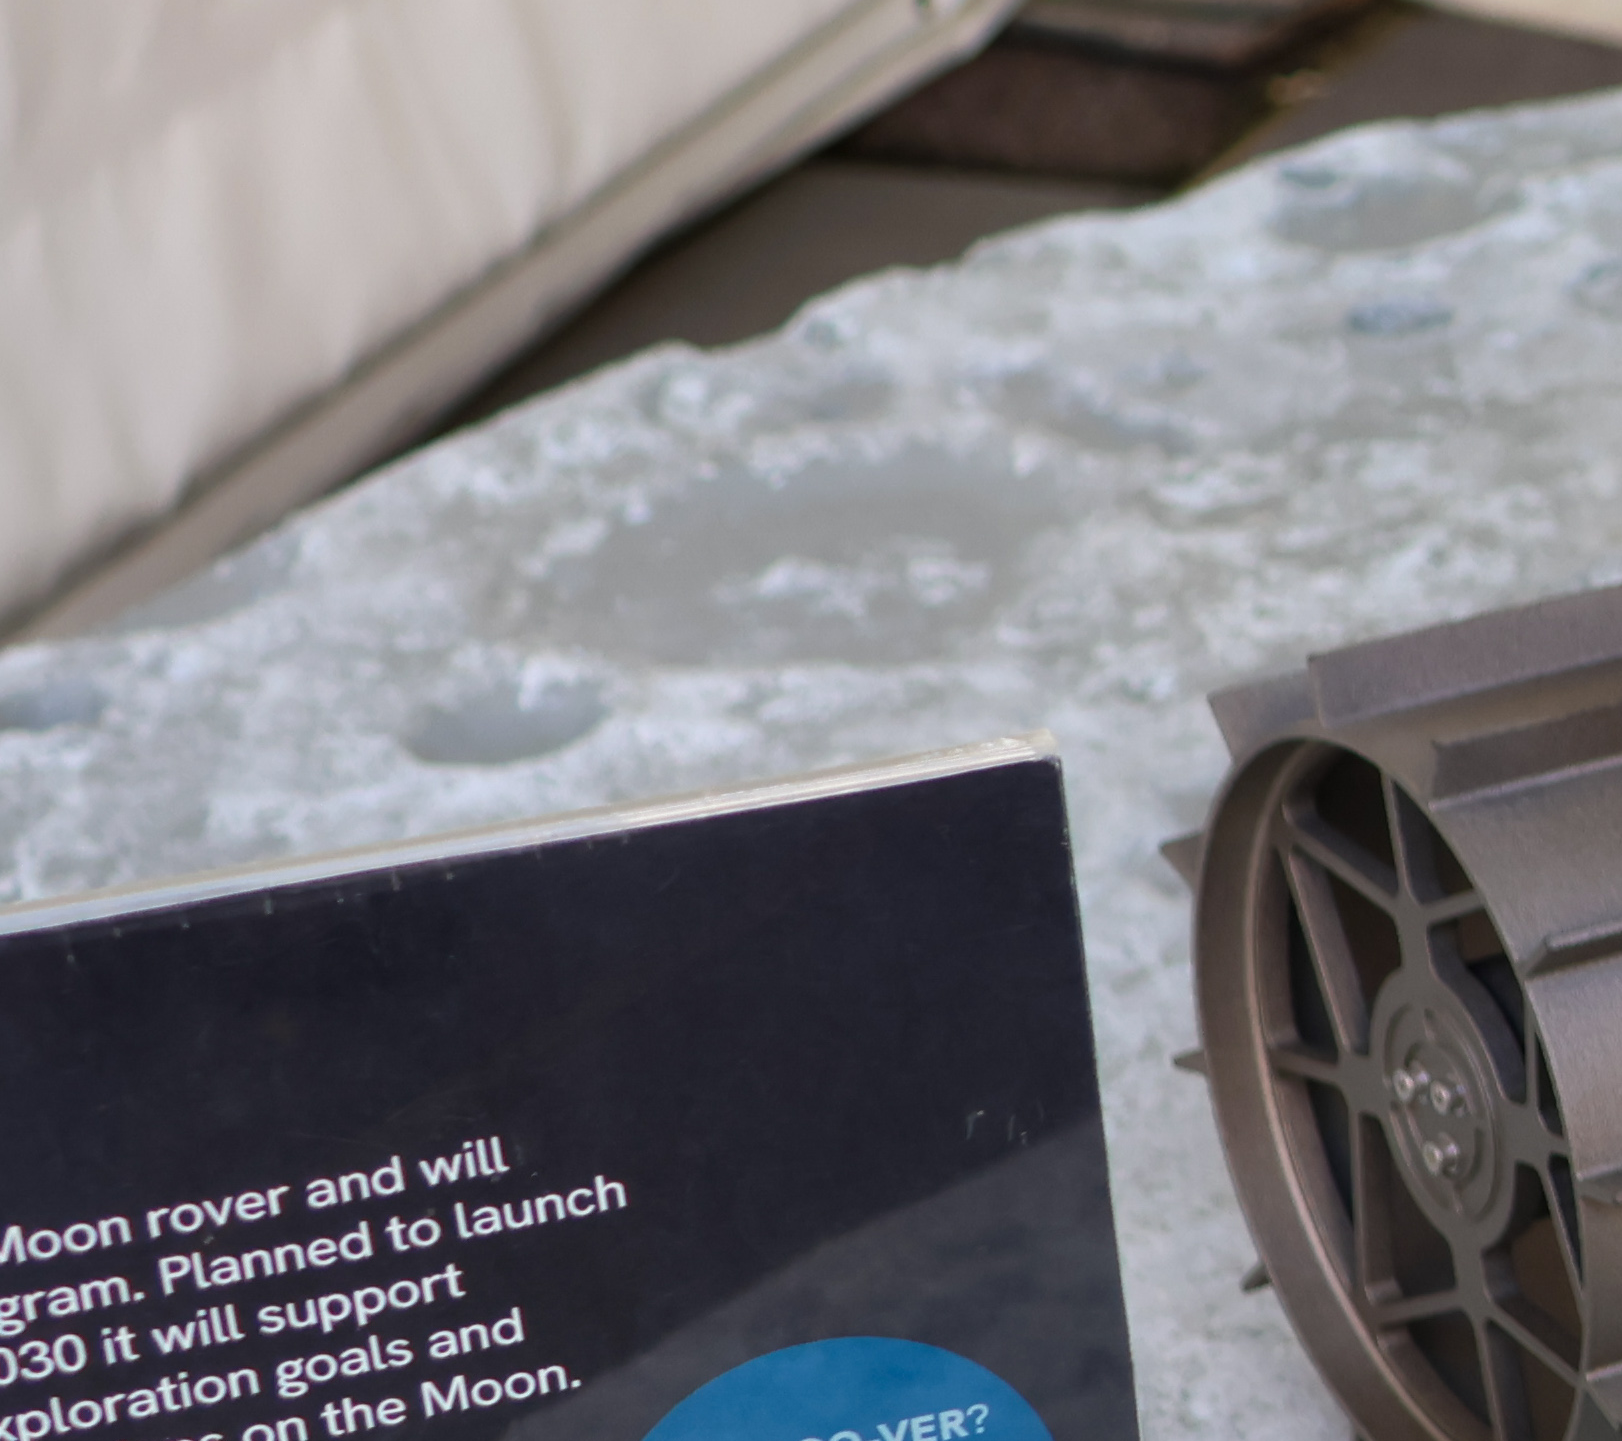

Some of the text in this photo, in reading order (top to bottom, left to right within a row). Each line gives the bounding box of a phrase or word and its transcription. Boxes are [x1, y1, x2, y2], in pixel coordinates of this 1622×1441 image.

[147, 1186, 289, 1238] rover
[307, 1156, 405, 1208] and
[419, 1136, 510, 1186] will
[159, 1221, 373, 1295] Planned
[385, 1217, 441, 1251] to
[455, 1175, 626, 1238] launch
[101, 1326, 140, 1364] it
[151, 1304, 245, 1354] will
[258, 1264, 466, 1333] support
[276, 1335, 413, 1398] goals
[429, 1307, 524, 1358] and
[320, 1398, 406, 1436] the
[421, 1366, 581, 1417] Moon.
